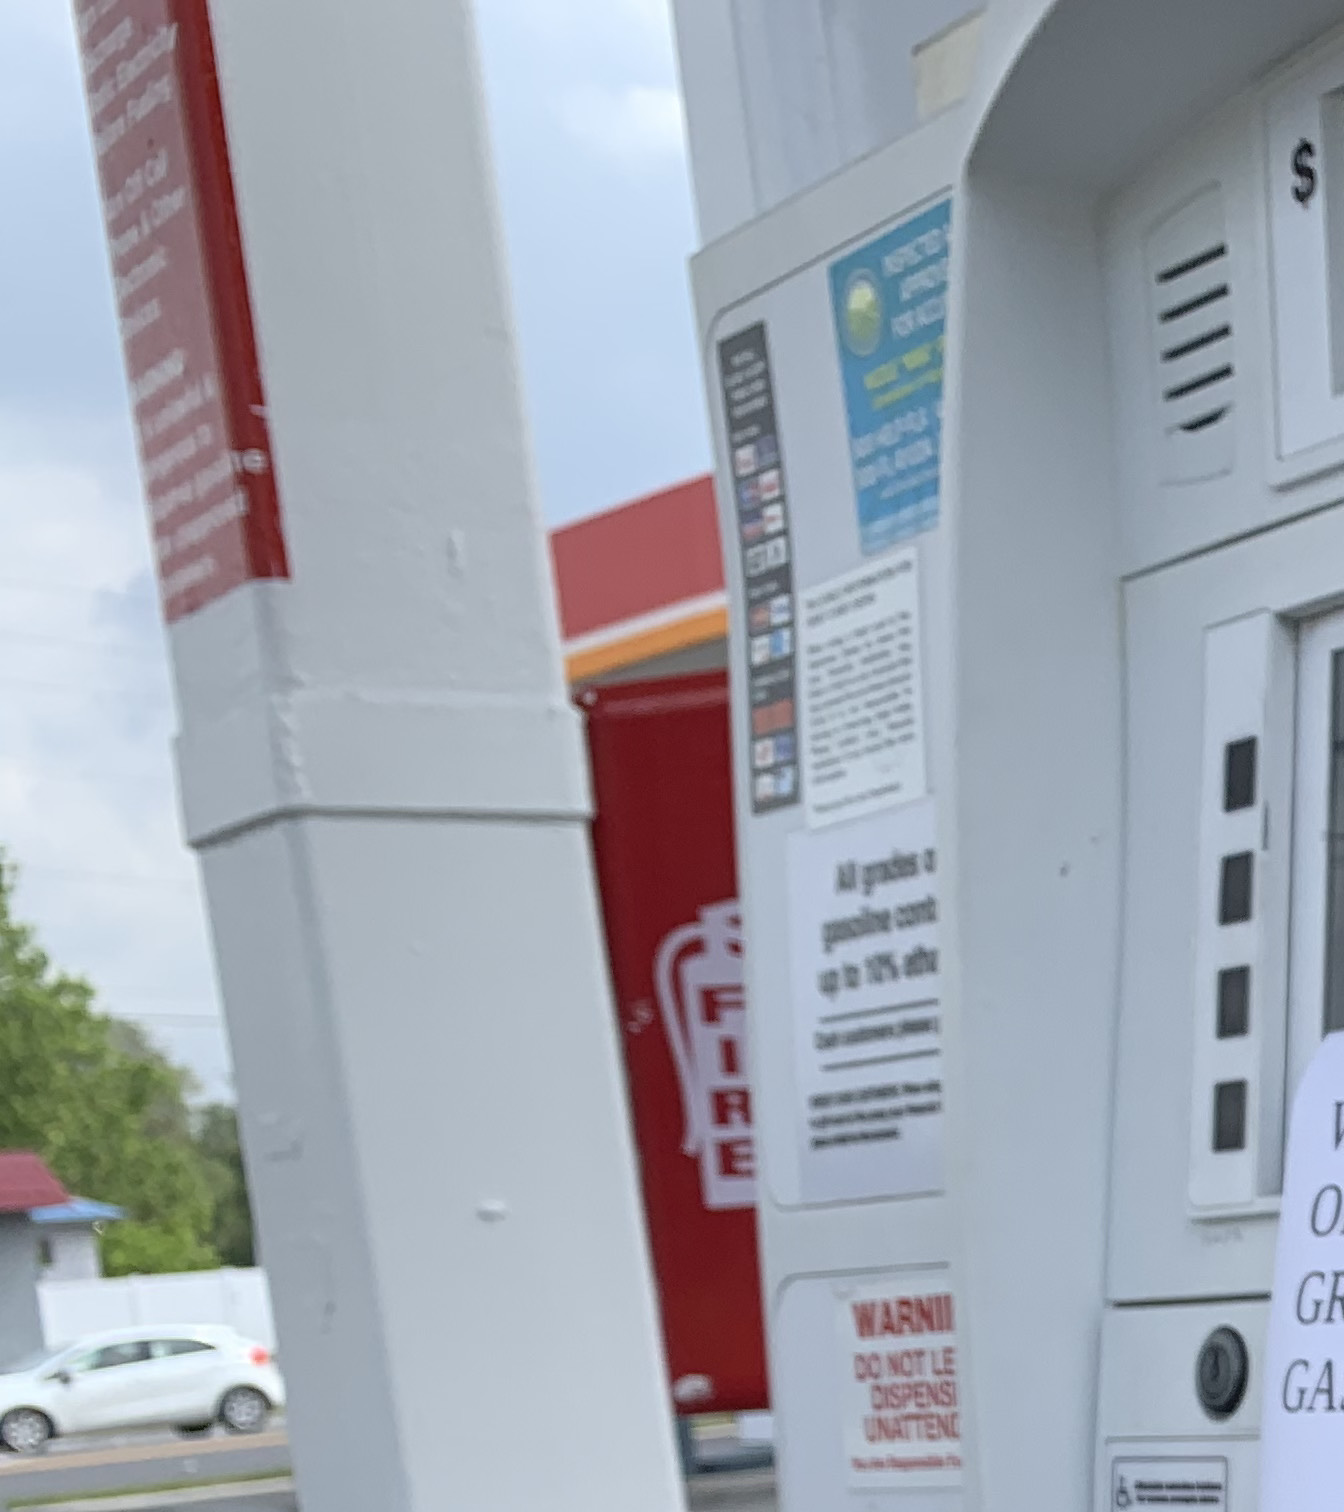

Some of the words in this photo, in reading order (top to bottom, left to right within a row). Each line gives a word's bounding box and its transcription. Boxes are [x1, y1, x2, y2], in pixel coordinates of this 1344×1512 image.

[1291, 138, 1317, 209] $
[861, 849, 919, 897] grades
[821, 905, 891, 956] gasoline
